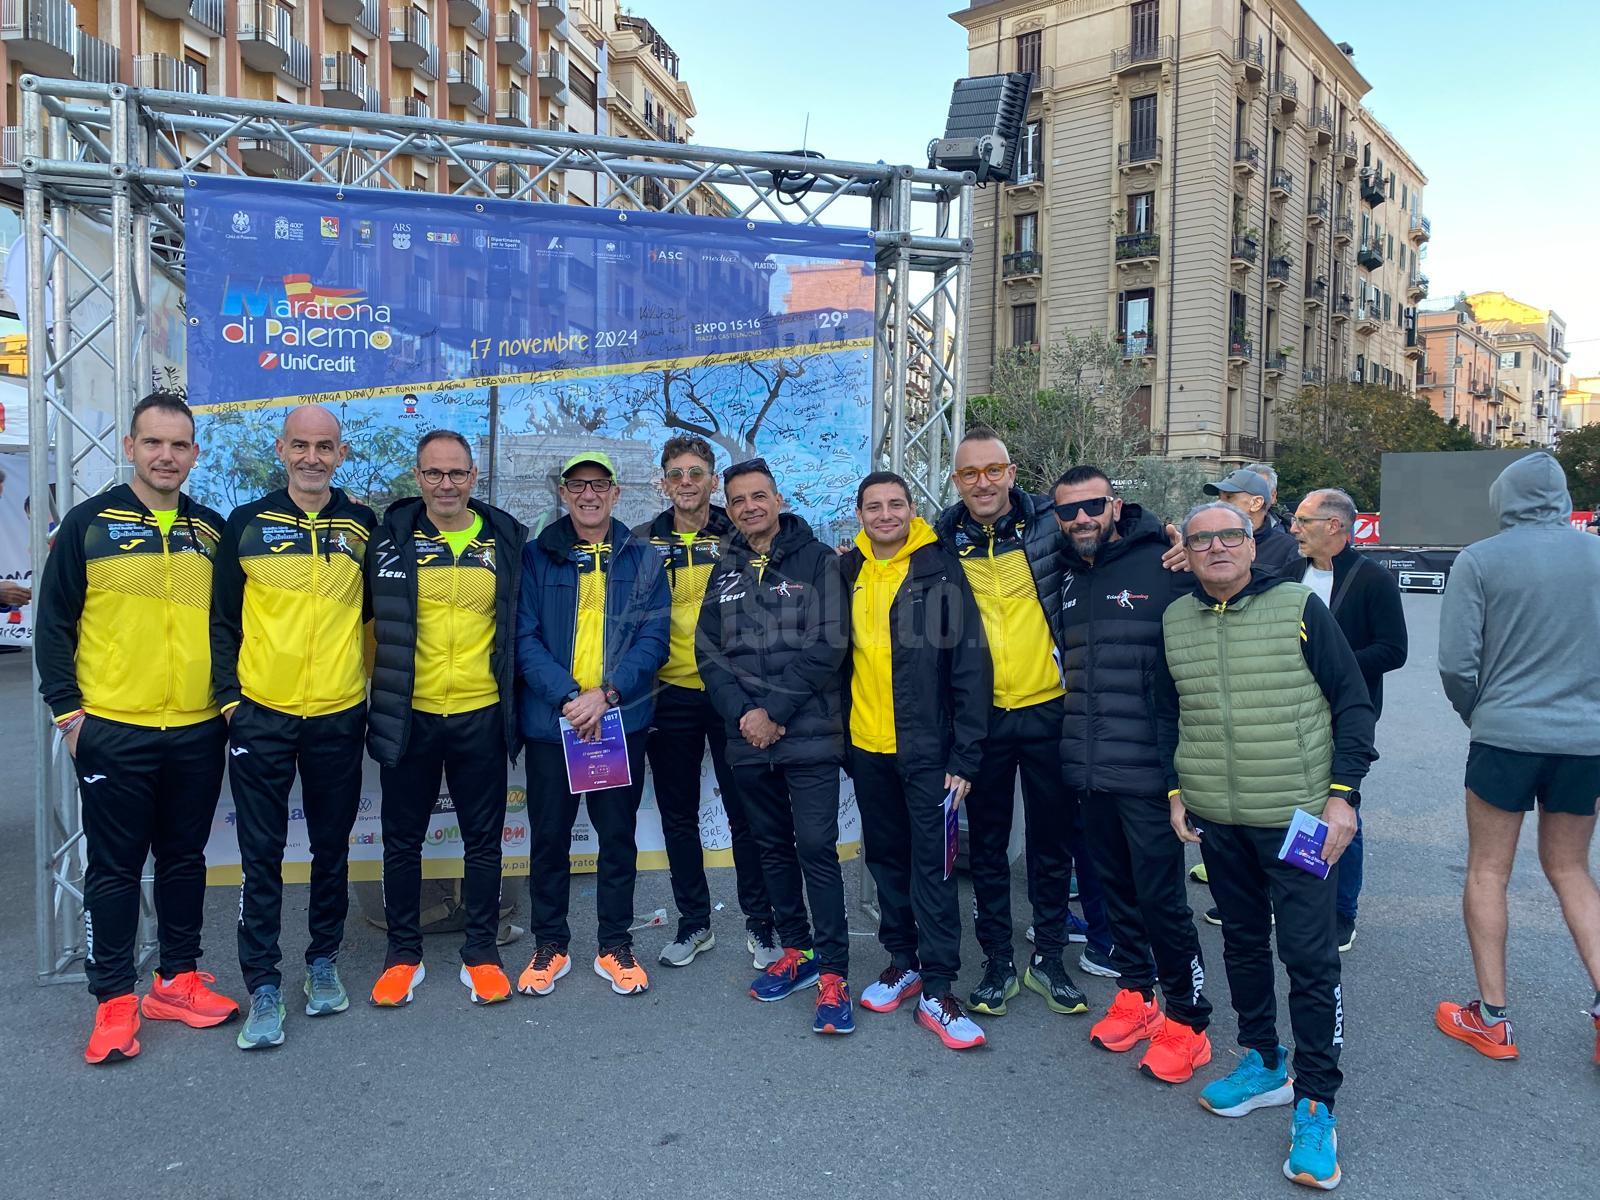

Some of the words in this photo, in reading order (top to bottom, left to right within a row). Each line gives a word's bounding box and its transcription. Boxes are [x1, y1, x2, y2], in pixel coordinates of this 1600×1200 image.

[392, 223, 411, 232] ARS
[658, 250, 683, 260] ASC
[221, 274, 391, 323] Maratona
[222, 316, 254, 345] di
[265, 318, 393, 350] Palermo
[695, 322, 727, 335] EXPO
[730, 318, 761, 331] 15-16
[470, 338, 492, 360] 17
[498, 331, 590, 357] novembre
[594, 329, 638, 349] 2024
[695, 334, 717, 342] PIAZZA
[280, 352, 356, 373] UniCredit
[719, 591, 746, 604] Zeus
